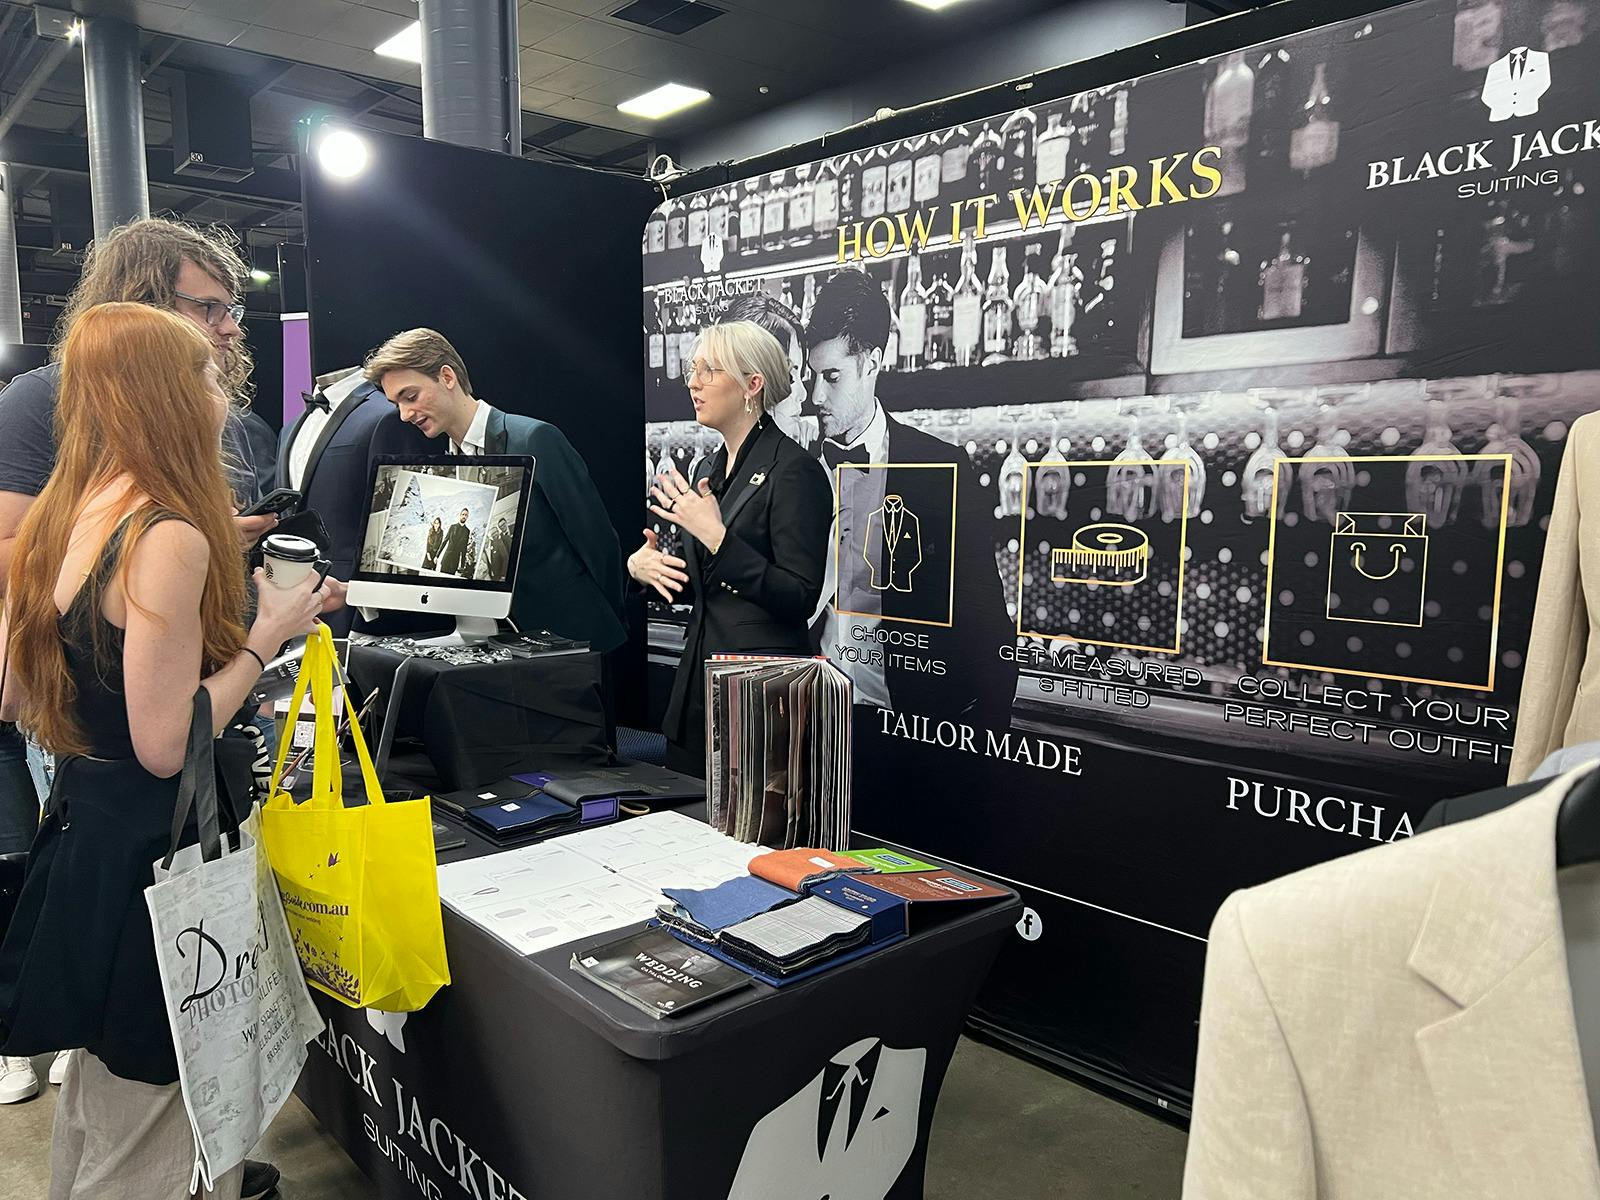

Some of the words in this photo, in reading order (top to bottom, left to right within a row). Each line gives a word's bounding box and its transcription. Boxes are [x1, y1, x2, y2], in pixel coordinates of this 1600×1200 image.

[190, 151, 204, 162] 30
[1366, 139, 1494, 190] BLACK
[1457, 169, 1559, 199] SUITING
[836, 205, 939, 264] HOW
[949, 193, 1000, 246] IT
[1008, 145, 1223, 232] WORKS
[663, 282, 708, 304] BLACK
[706, 277, 764, 304] JACKET
[850, 624, 930, 650] CHOOSE
[835, 644, 884, 668] YOUR
[887, 653, 948, 676] ITEMS
[998, 644, 1045, 664] GET
[1052, 652, 1204, 687] MEASURED
[1062, 680, 1151, 708] FITTED
[1237, 675, 1392, 713] COLLECT
[1404, 696, 1511, 731] YOUR
[876, 708, 978, 755] TAILOR
[985, 728, 1083, 776] MADE
[1223, 703, 1377, 744] PERFECT
[634, 951, 704, 990] WEDDING
[362, 1112, 443, 1200] SUITING
